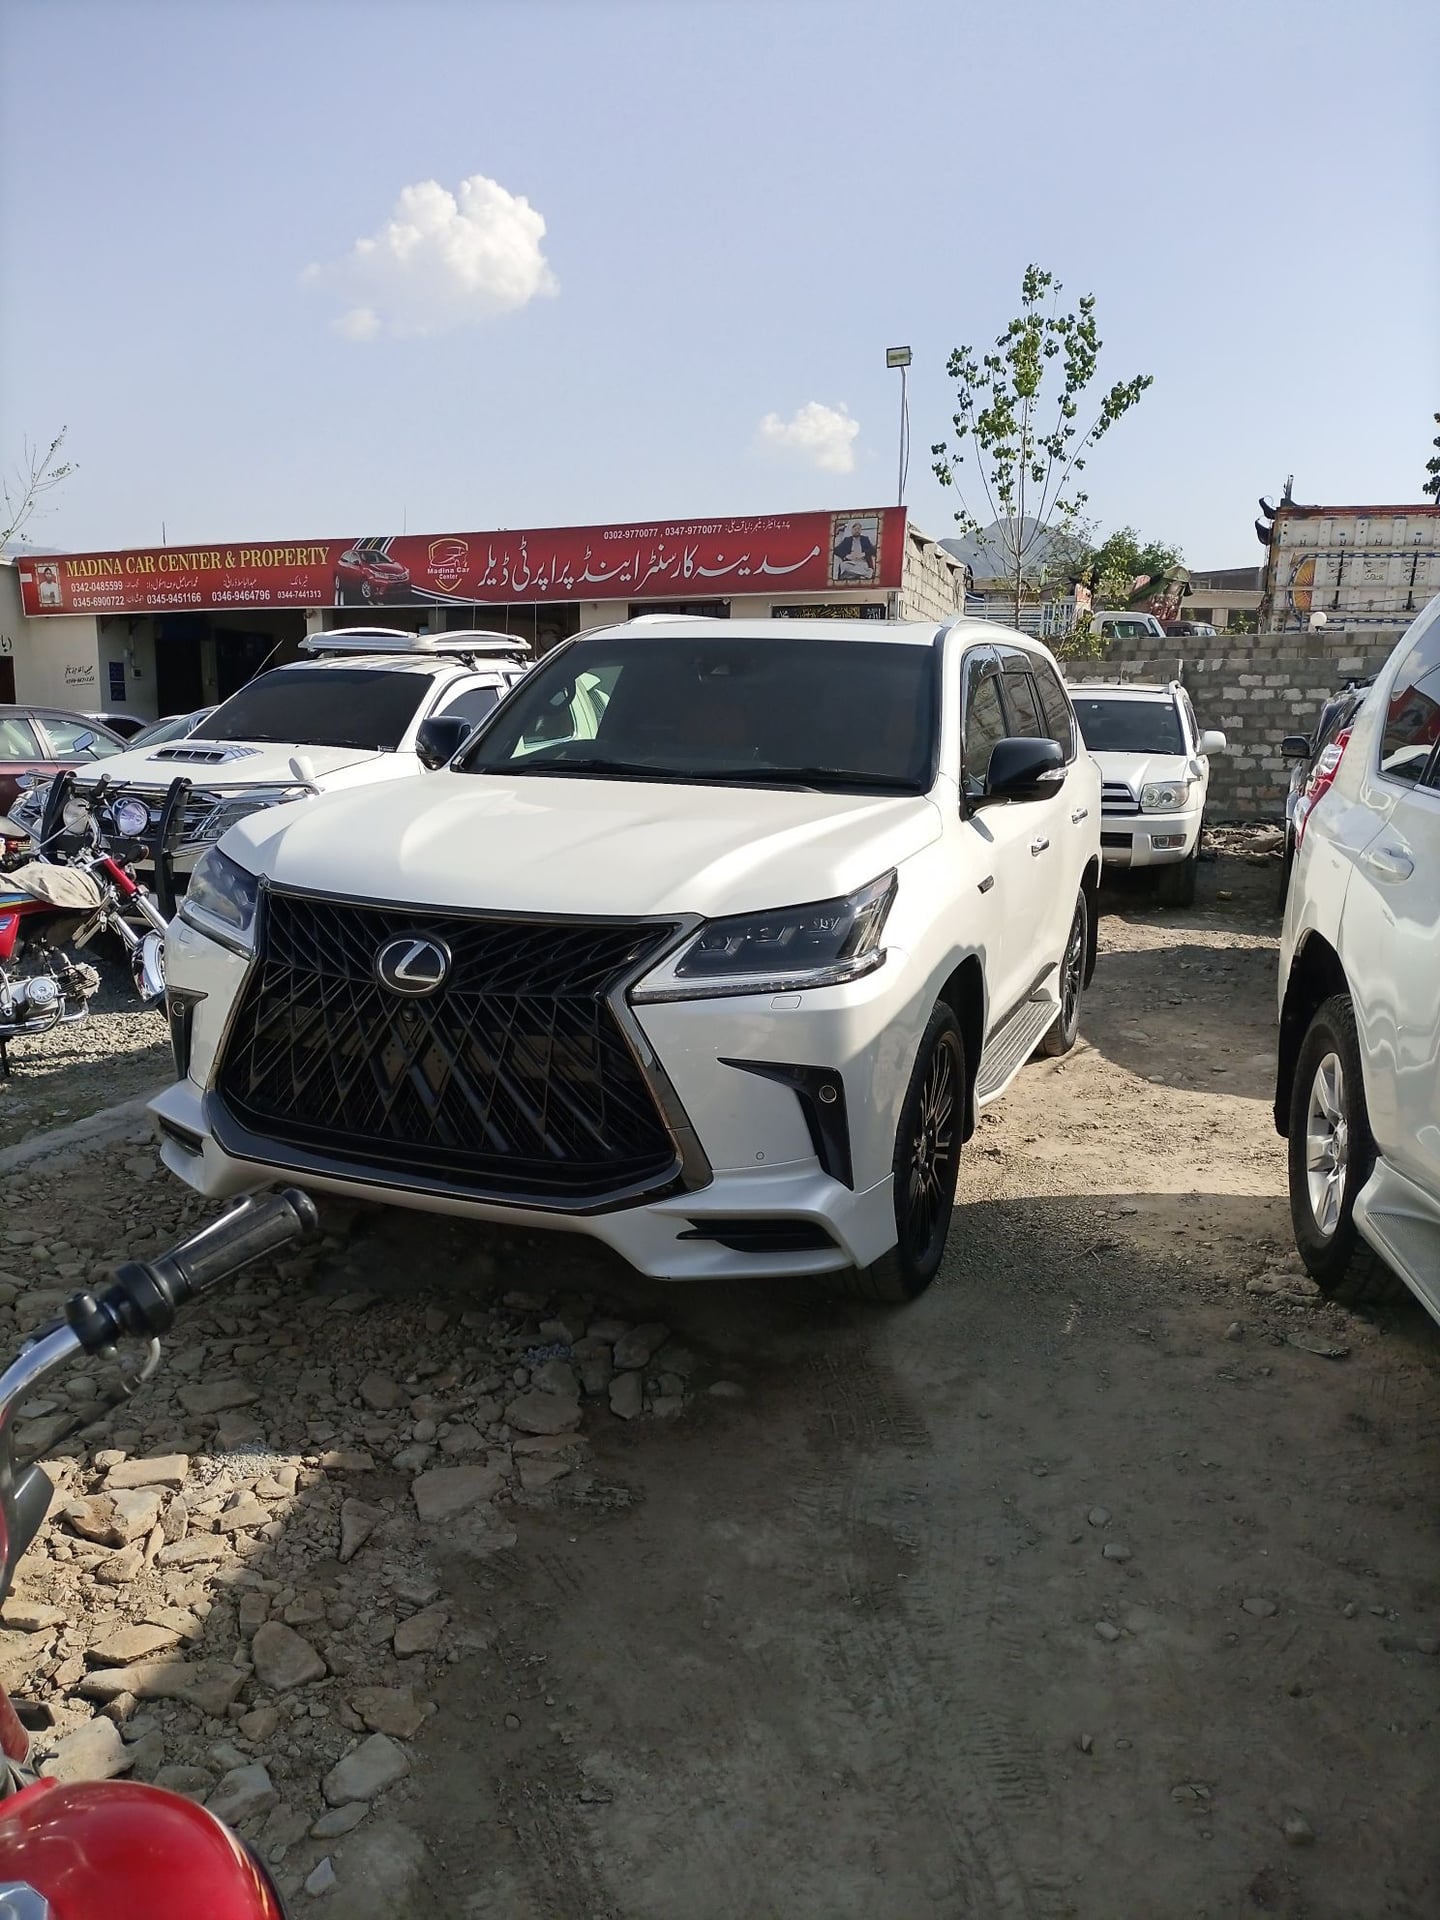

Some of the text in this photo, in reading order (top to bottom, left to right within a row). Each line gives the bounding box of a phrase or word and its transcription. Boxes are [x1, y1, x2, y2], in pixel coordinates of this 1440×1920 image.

[603, 528, 659, 540] 0302-9770077
[665, 524, 723, 536] 0347-9770077
[65, 546, 330, 578] MADINA CAR CENTER & PROPERTY
[477, 543, 510, 587] ڈیلر
[511, 535, 575, 592] پراپرٹی
[576, 545, 640, 583] اینڈ
[670, 544, 699, 579] کار
[692, 545, 821, 580] مدینہ
[70, 580, 123, 593] 0342-0485599
[146, 592, 202, 605] 0345-9451166
[211, 589, 271, 602] 0346-9464796
[277, 590, 322, 599] 0344-7441313
[72, 595, 125, 607] 0345-6900722
